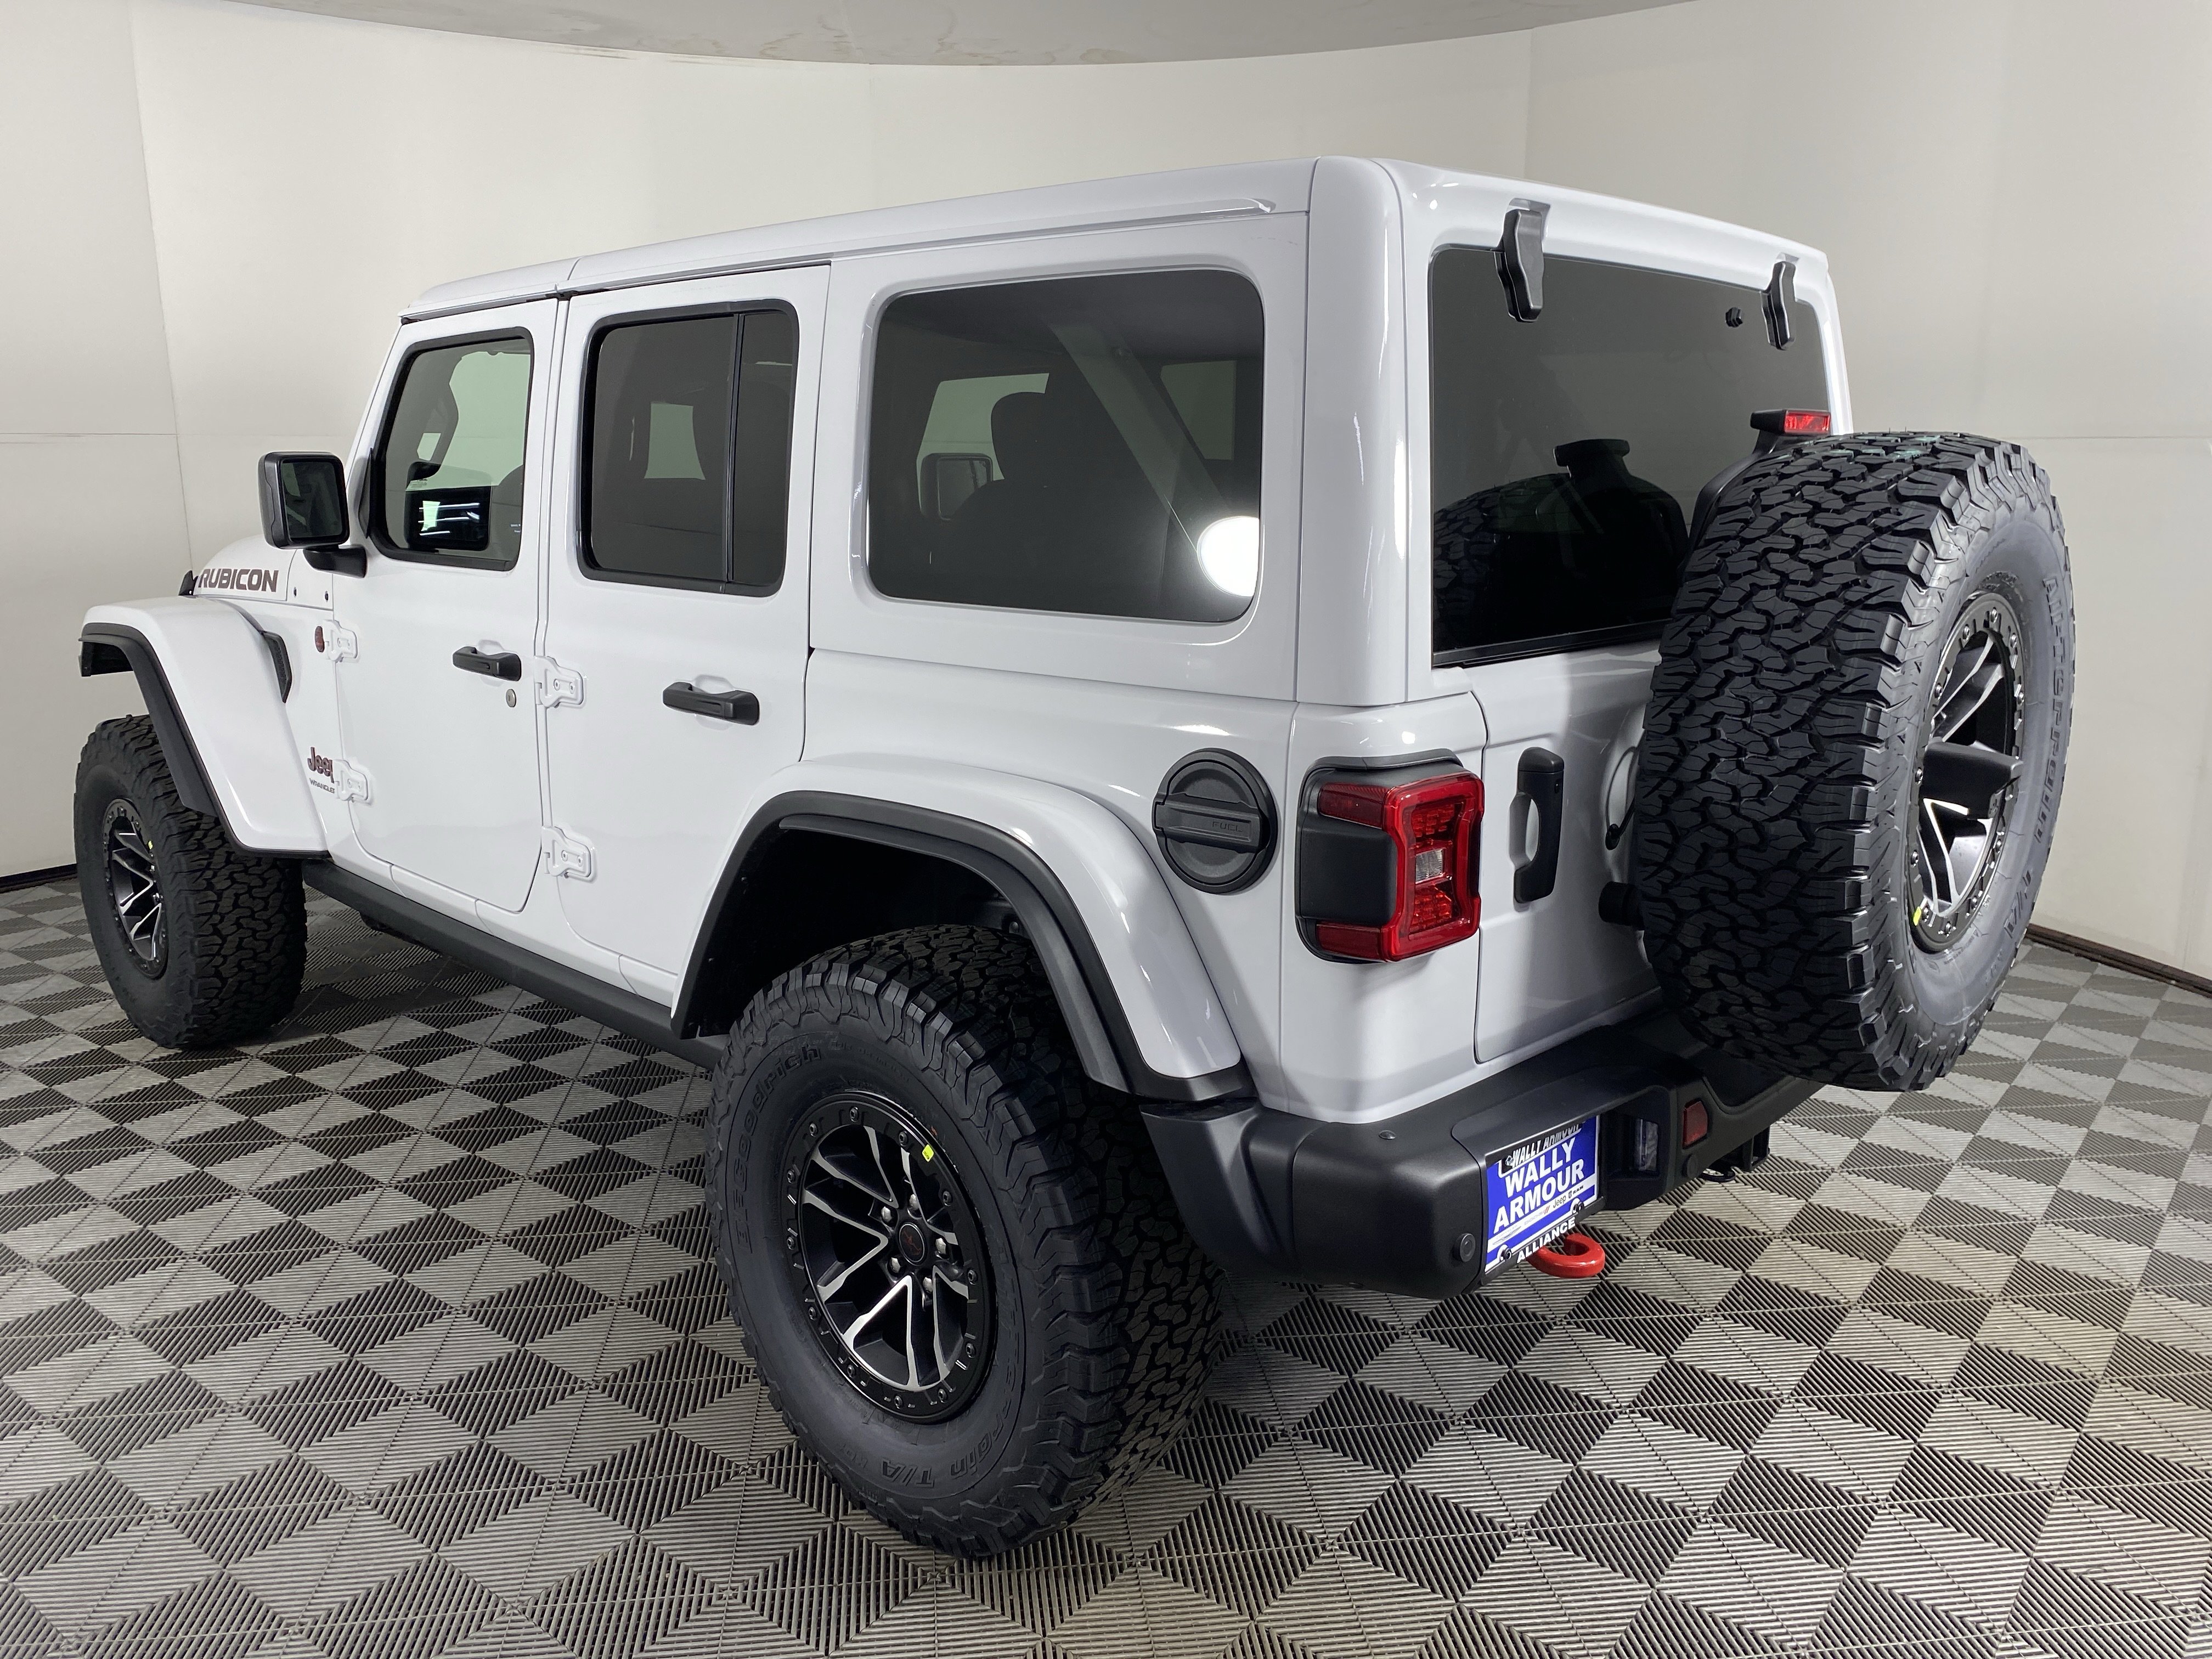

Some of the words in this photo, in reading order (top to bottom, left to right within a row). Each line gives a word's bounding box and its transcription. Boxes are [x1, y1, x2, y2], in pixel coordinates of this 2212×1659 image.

[199, 568, 279, 592] RUBICON
[307, 746, 334, 783] Jeep
[309, 777, 335, 793] WRANGLE
[1212, 821, 1243, 832] FUEL
[1505, 1137, 1576, 1198] WALLY
[1493, 1159, 1584, 1234] ARMOUR
[1553, 1195, 1566, 1209] Jeep
[1573, 1185, 1584, 1195] RAM
[1516, 1216, 1576, 1263] ALLIANCE
